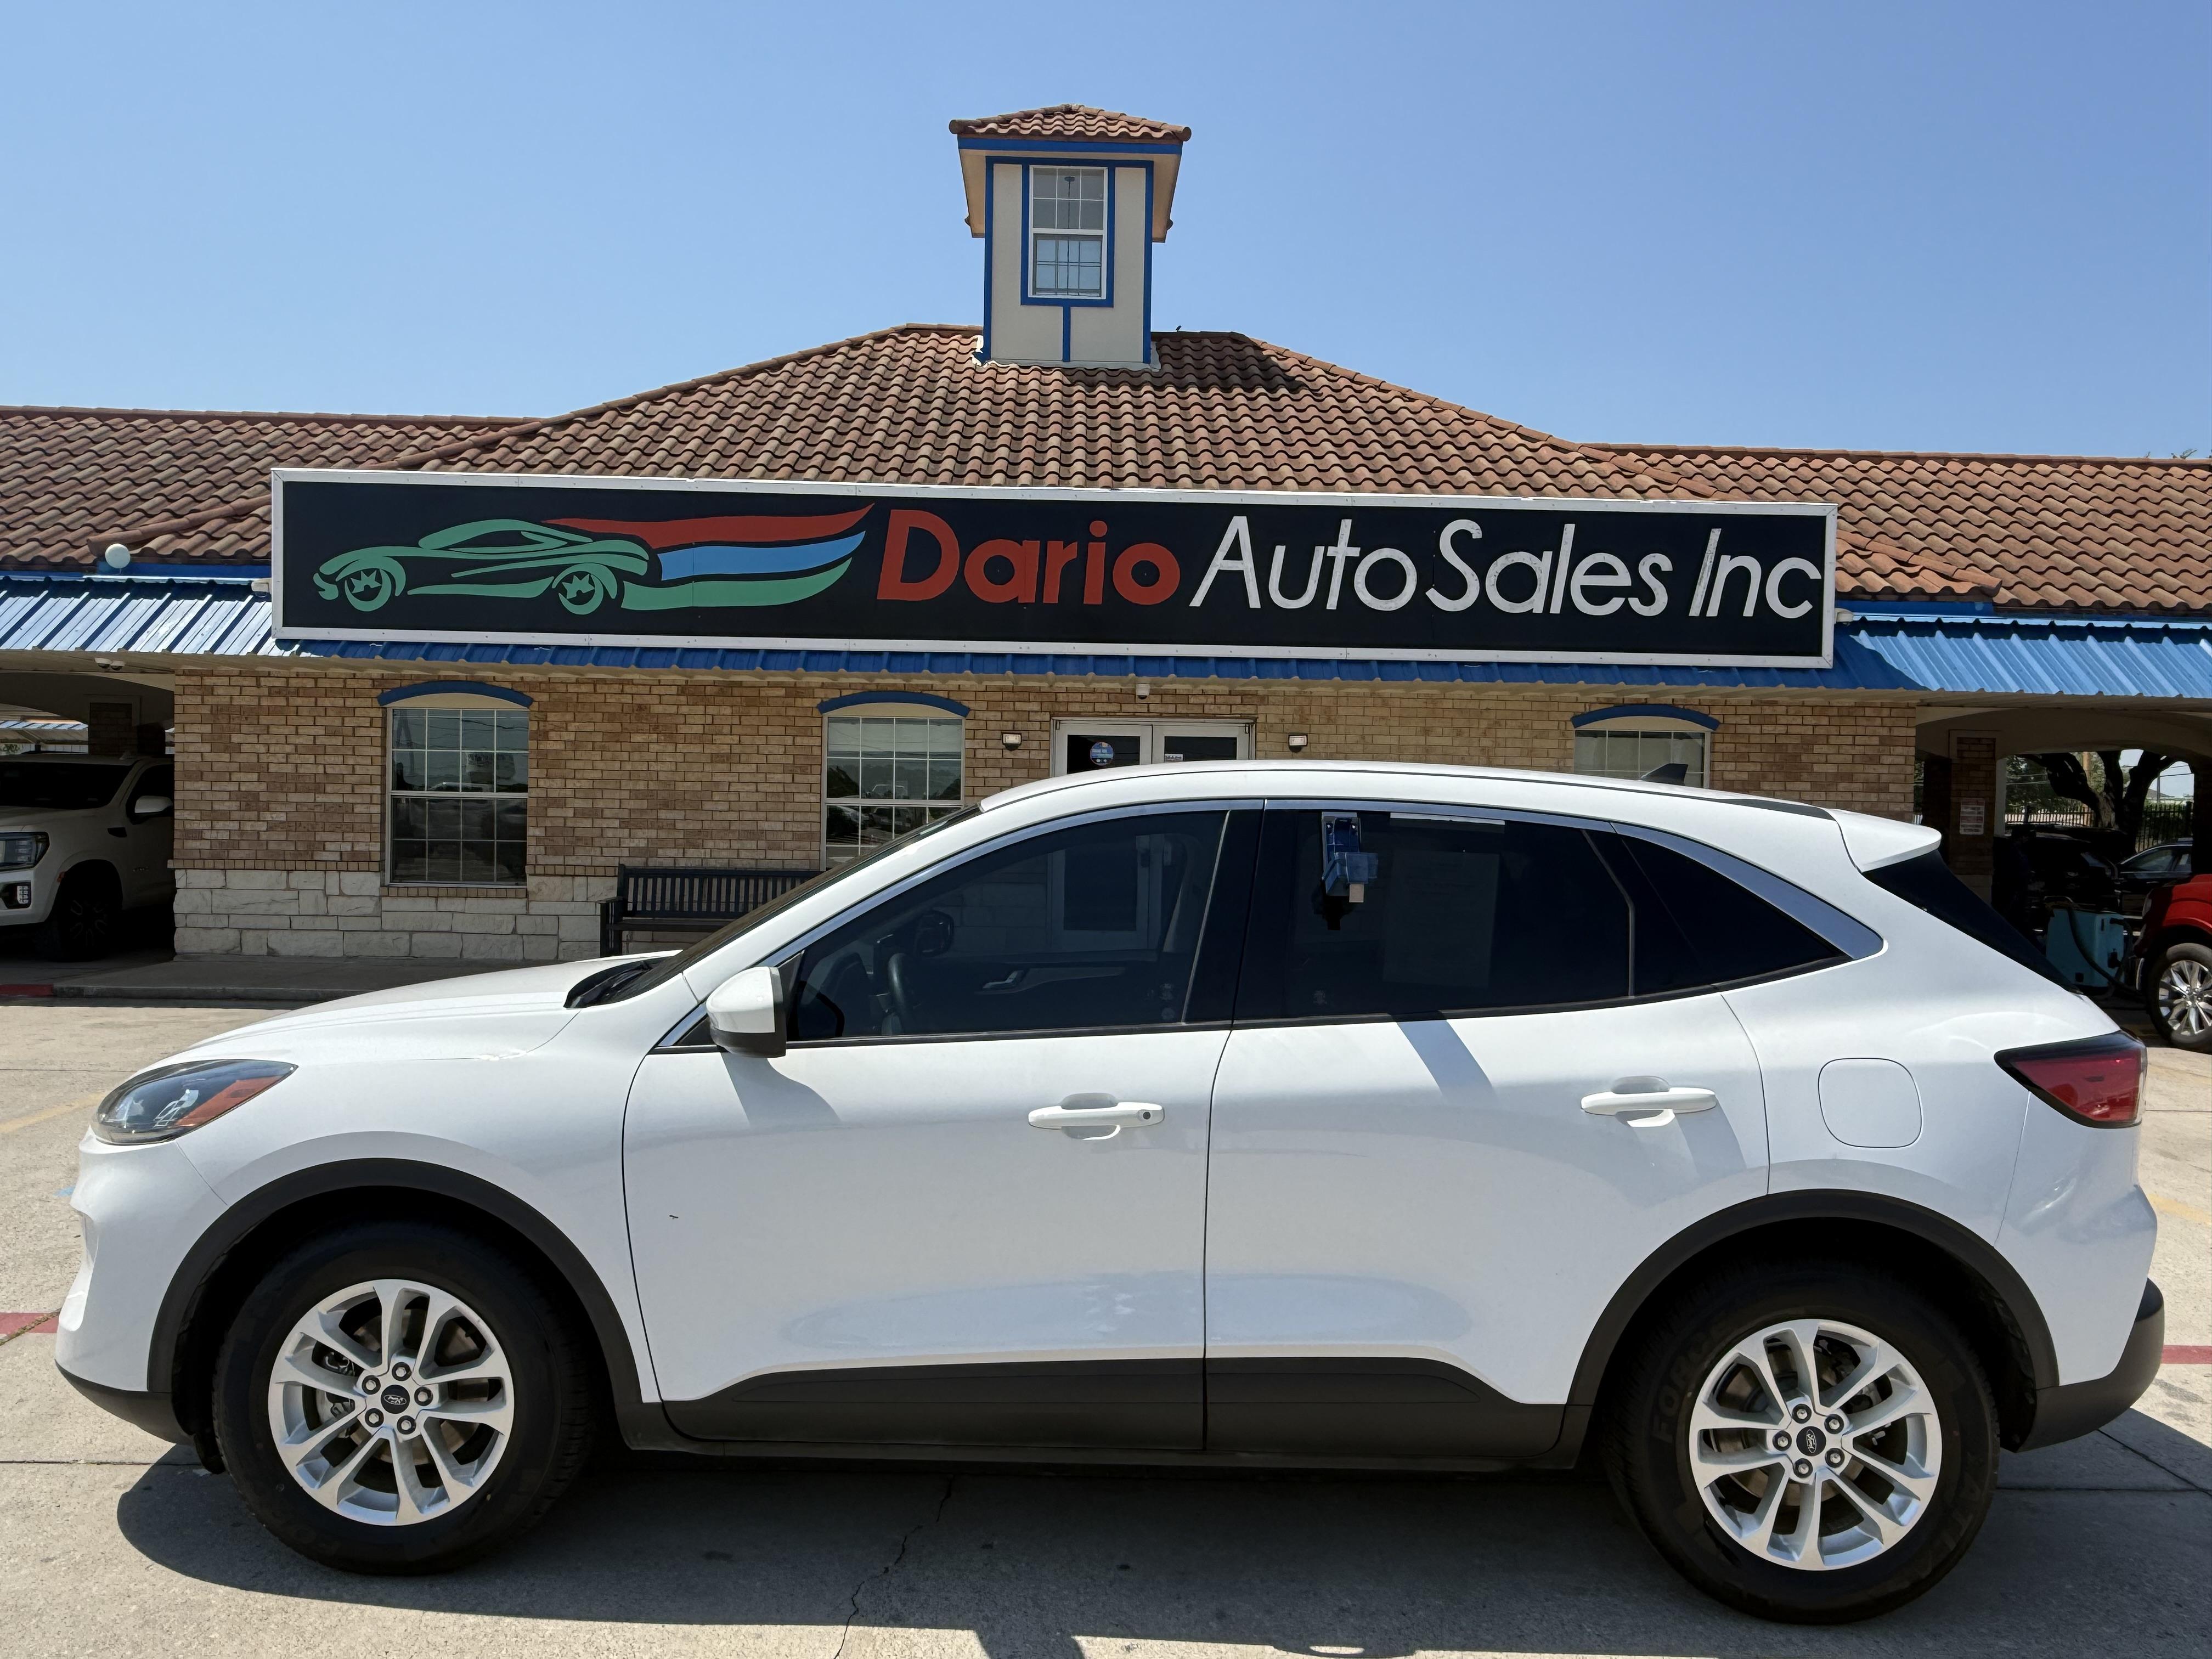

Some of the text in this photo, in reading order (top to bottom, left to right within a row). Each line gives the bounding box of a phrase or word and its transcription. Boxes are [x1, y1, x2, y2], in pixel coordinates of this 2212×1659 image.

[876, 509, 1822, 619] Dario Auto Sales Inc
